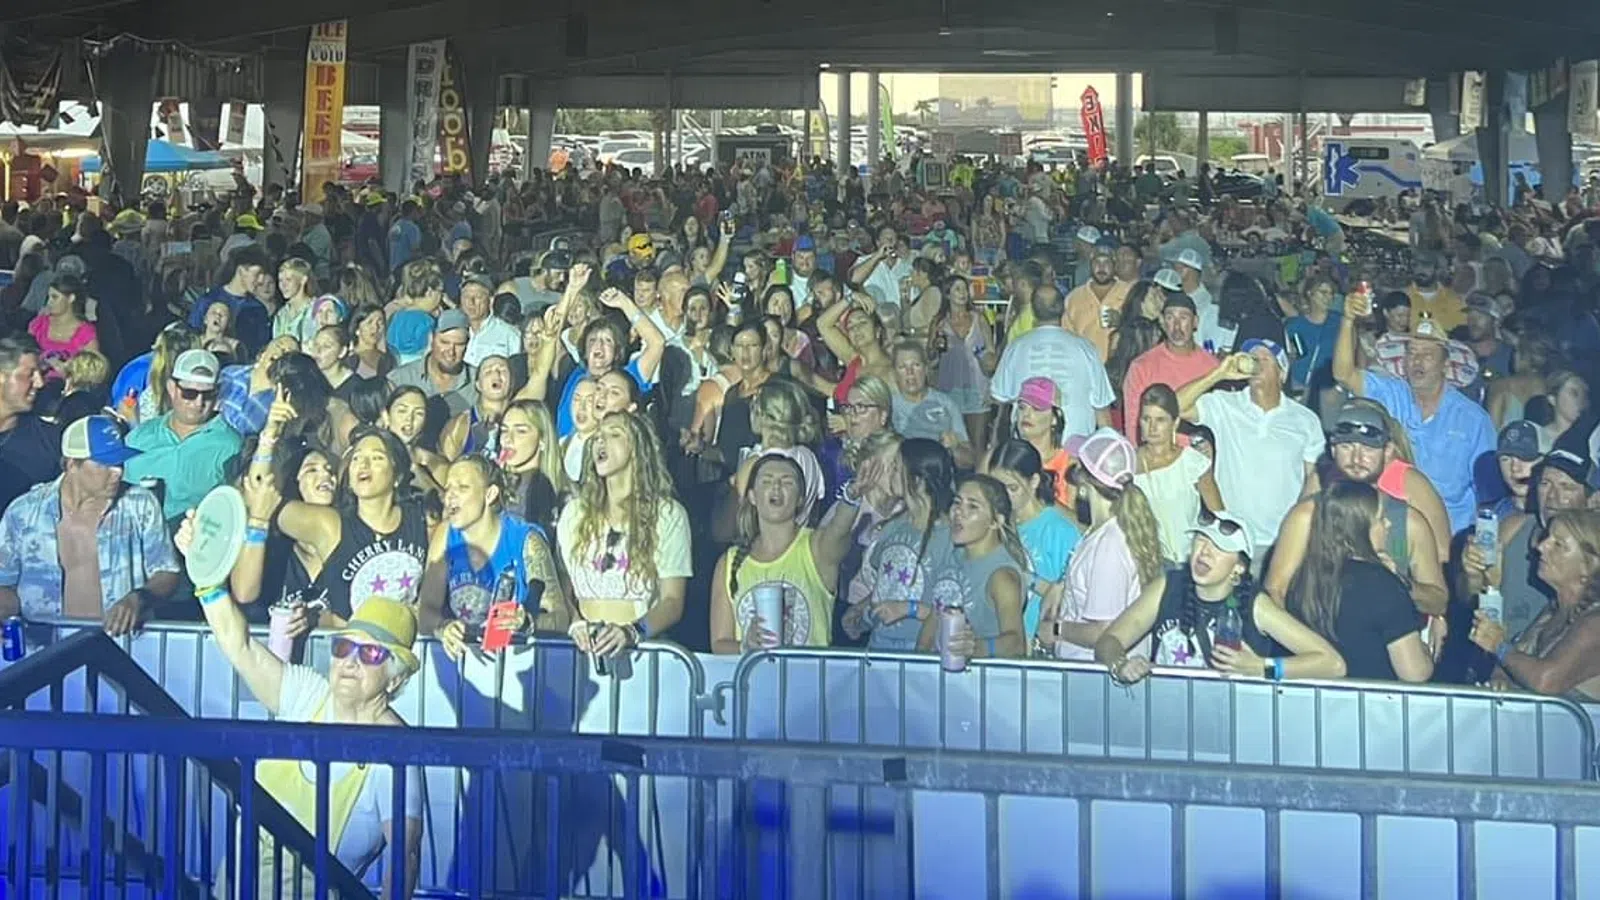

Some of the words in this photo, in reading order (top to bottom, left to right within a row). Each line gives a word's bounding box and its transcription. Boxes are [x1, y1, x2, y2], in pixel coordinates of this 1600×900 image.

[316, 23, 344, 37] ICE
[311, 43, 344, 61] COLD
[312, 65, 337, 159] BEER
[742, 151, 767, 159] ATM
[342, 540, 391, 581] CHERRY
